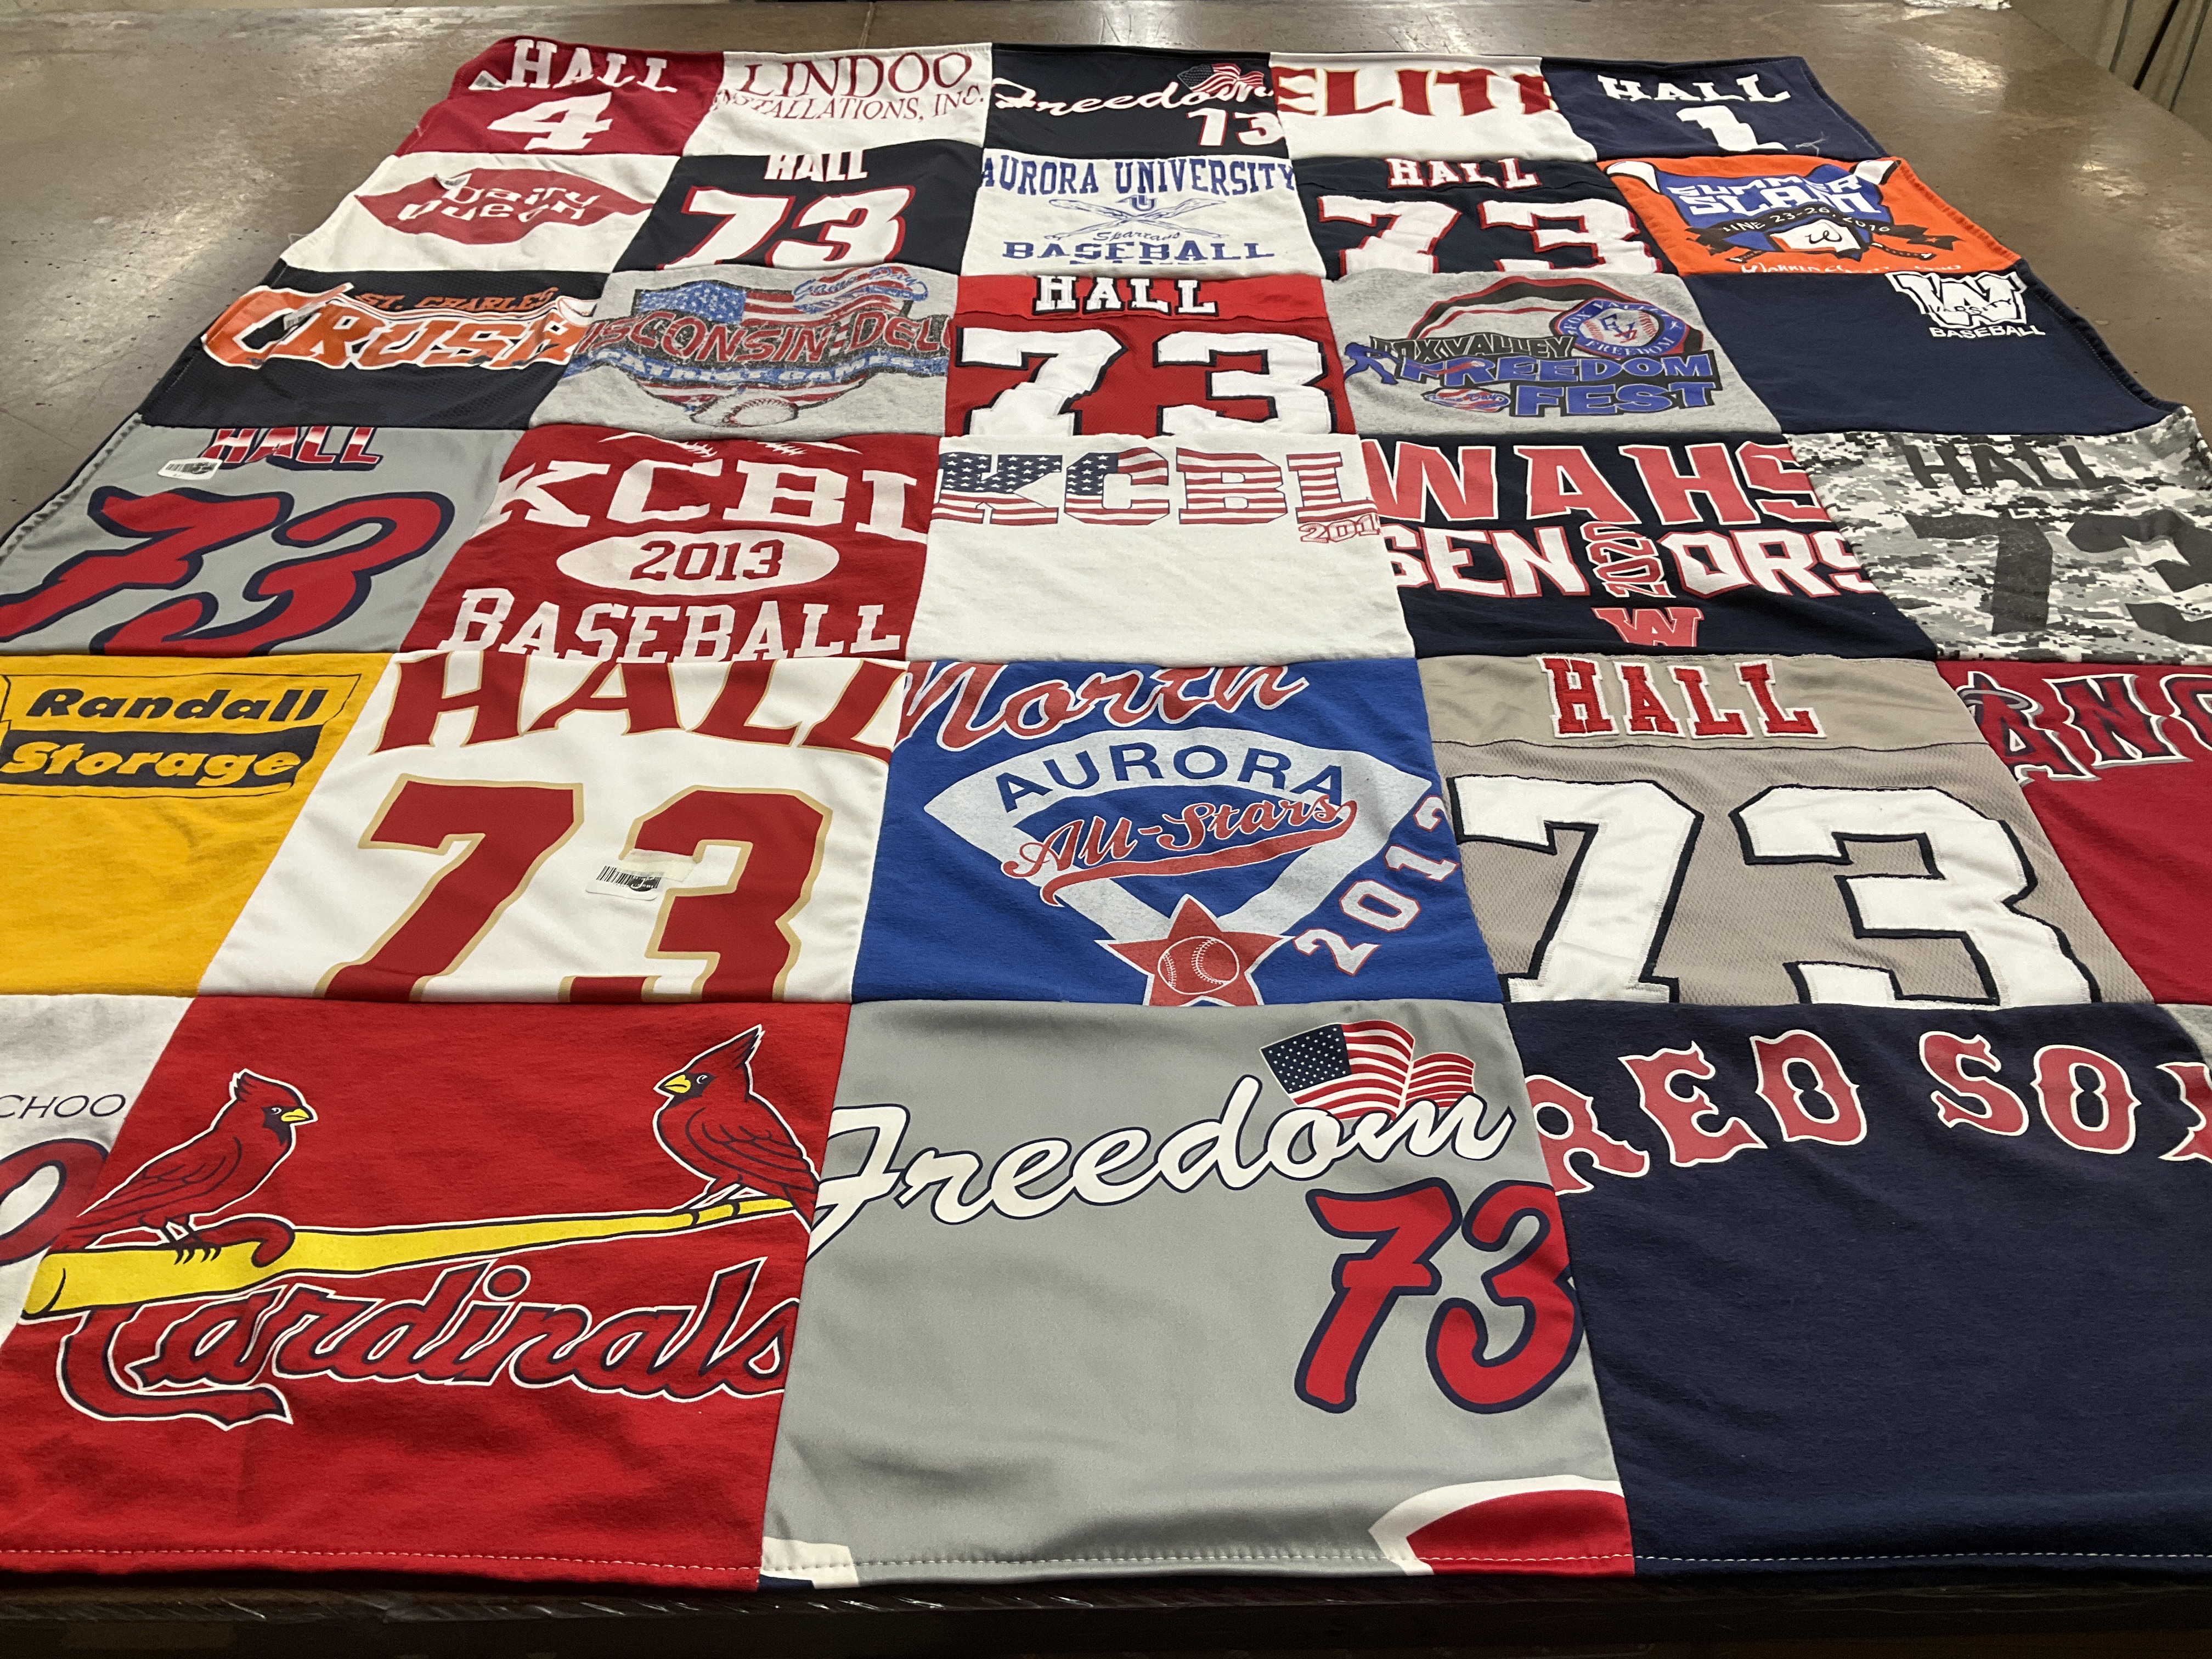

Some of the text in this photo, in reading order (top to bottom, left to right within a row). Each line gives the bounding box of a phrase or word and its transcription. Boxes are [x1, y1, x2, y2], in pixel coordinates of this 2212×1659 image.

[505, 39, 677, 92] HALL
[736, 52, 973, 98] LINDOO
[1597, 74, 1791, 102] HALL
[487, 91, 613, 151] 4
[992, 77, 1274, 116] Freedom
[1675, 105, 1787, 152] 1
[764, 149, 868, 182] HALL
[981, 154, 1295, 196] AURORA UNIVERSITY
[1385, 157, 1542, 189] HALL
[657, 184, 916, 270] 73
[1679, 185, 1882, 216] SLAM
[1002, 240, 1276, 261] BASEBALL
[1318, 195, 1663, 275] 73
[414, 286, 559, 311] CHARLES
[1032, 275, 1220, 317] HALL
[202, 283, 583, 370] CRUSH
[574, 309, 951, 363] ISCONSIN DEL
[1929, 325, 2046, 339] BASEBALL
[956, 326, 1338, 437] 73
[1399, 354, 1714, 387] FREEDOM
[1513, 381, 1718, 416] FEST
[199, 426, 383, 466] HALL
[1902, 444, 2129, 492] HALL
[1361, 439, 1833, 526] WAHS
[1298, 514, 1381, 544] 201
[0, 486, 455, 656] 73
[630, 538, 784, 582] 2013
[1904, 507, 2212, 647] 73
[437, 588, 902, 664] BASEBALL
[26, 688, 329, 721] Randall
[369, 650, 911, 766] HALL
[892, 662, 1310, 752] North
[1537, 654, 1827, 740] HALL
[0, 741, 301, 787] Storage
[994, 740, 1342, 814] AURORA
[1001, 793, 1356, 879] All-Stars
[314, 772, 834, 1003] 73
[1446, 773, 2102, 1007] 73
[1524, 1029, 1868, 1196] RED
[806, 1074, 1517, 1260] Freedom
[1294, 1177, 1584, 1414] 73
[57, 1255, 802, 1431] Cardinals
